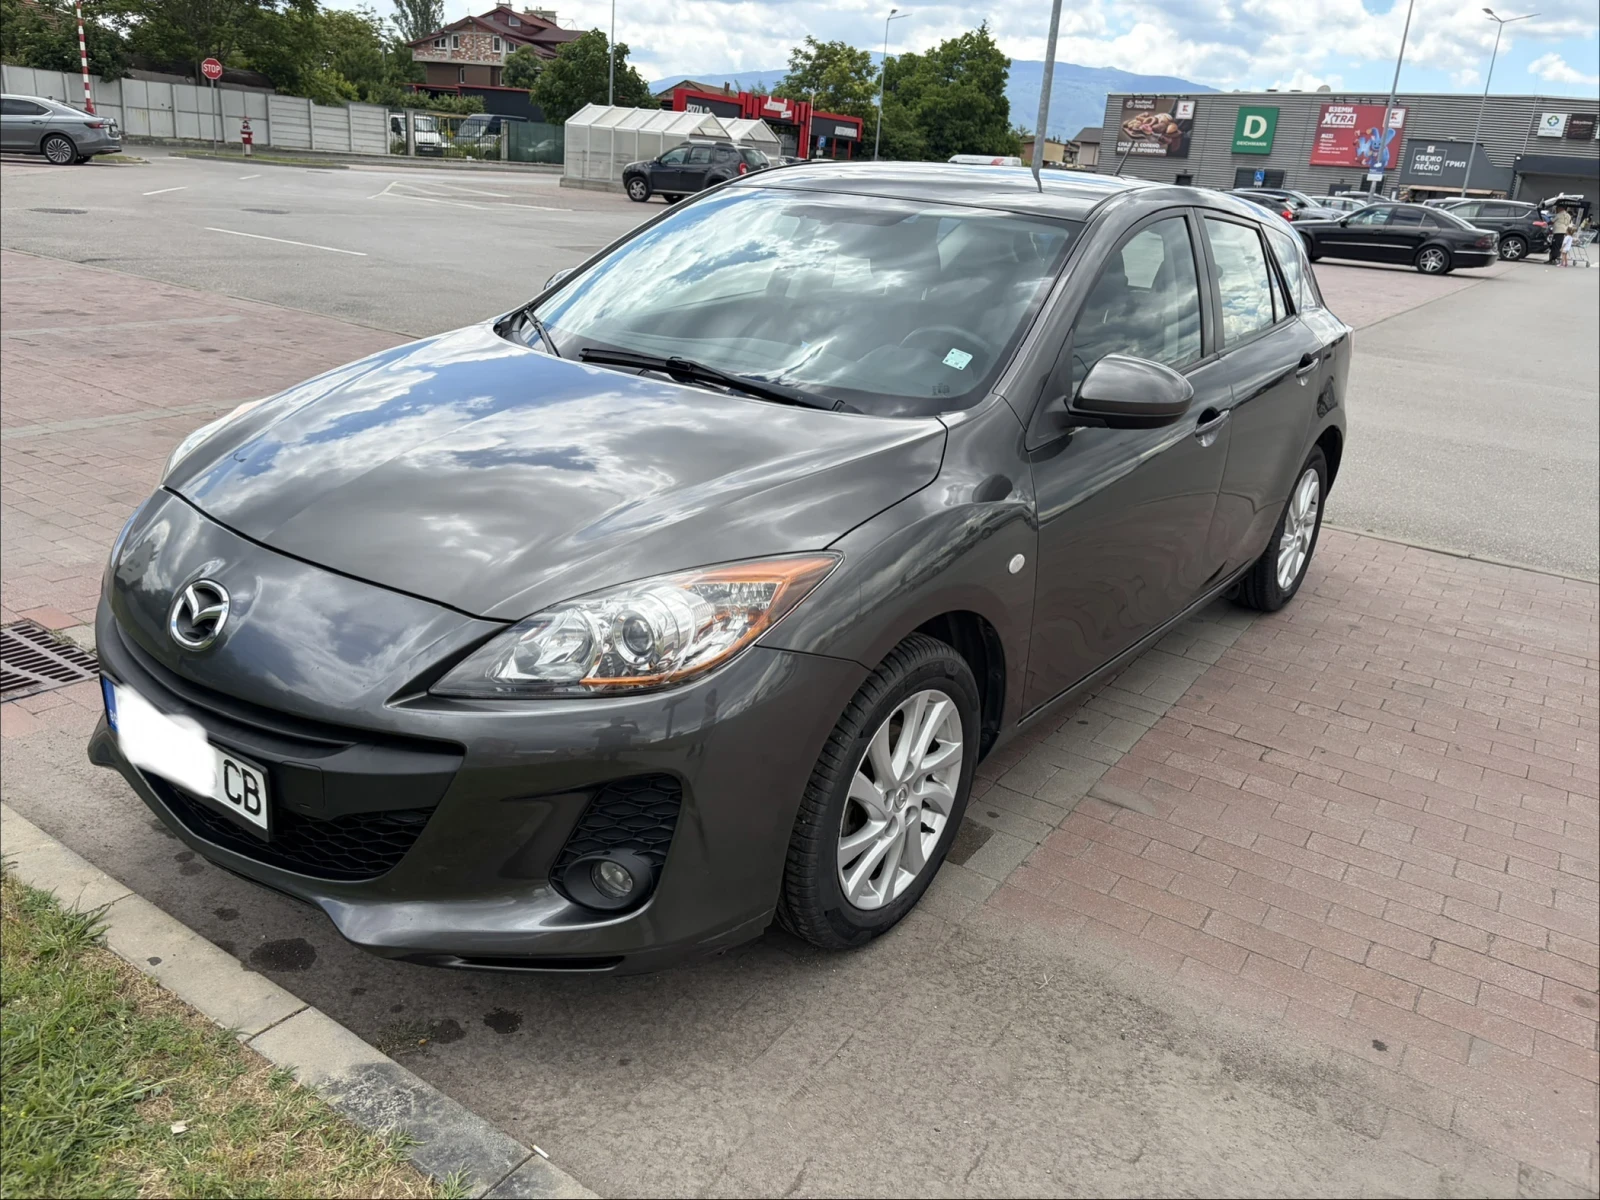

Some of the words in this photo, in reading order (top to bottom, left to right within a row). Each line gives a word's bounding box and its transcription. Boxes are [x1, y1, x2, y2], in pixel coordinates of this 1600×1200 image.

[203, 63, 221, 74] STOP
[1243, 115, 1267, 139] D
[1415, 154, 1442, 163] СВЕЖО
[1413, 163, 1440, 171] ЛЕСНО
[1445, 160, 1466, 168] ГРИЛ
[223, 758, 262, 817] CB
